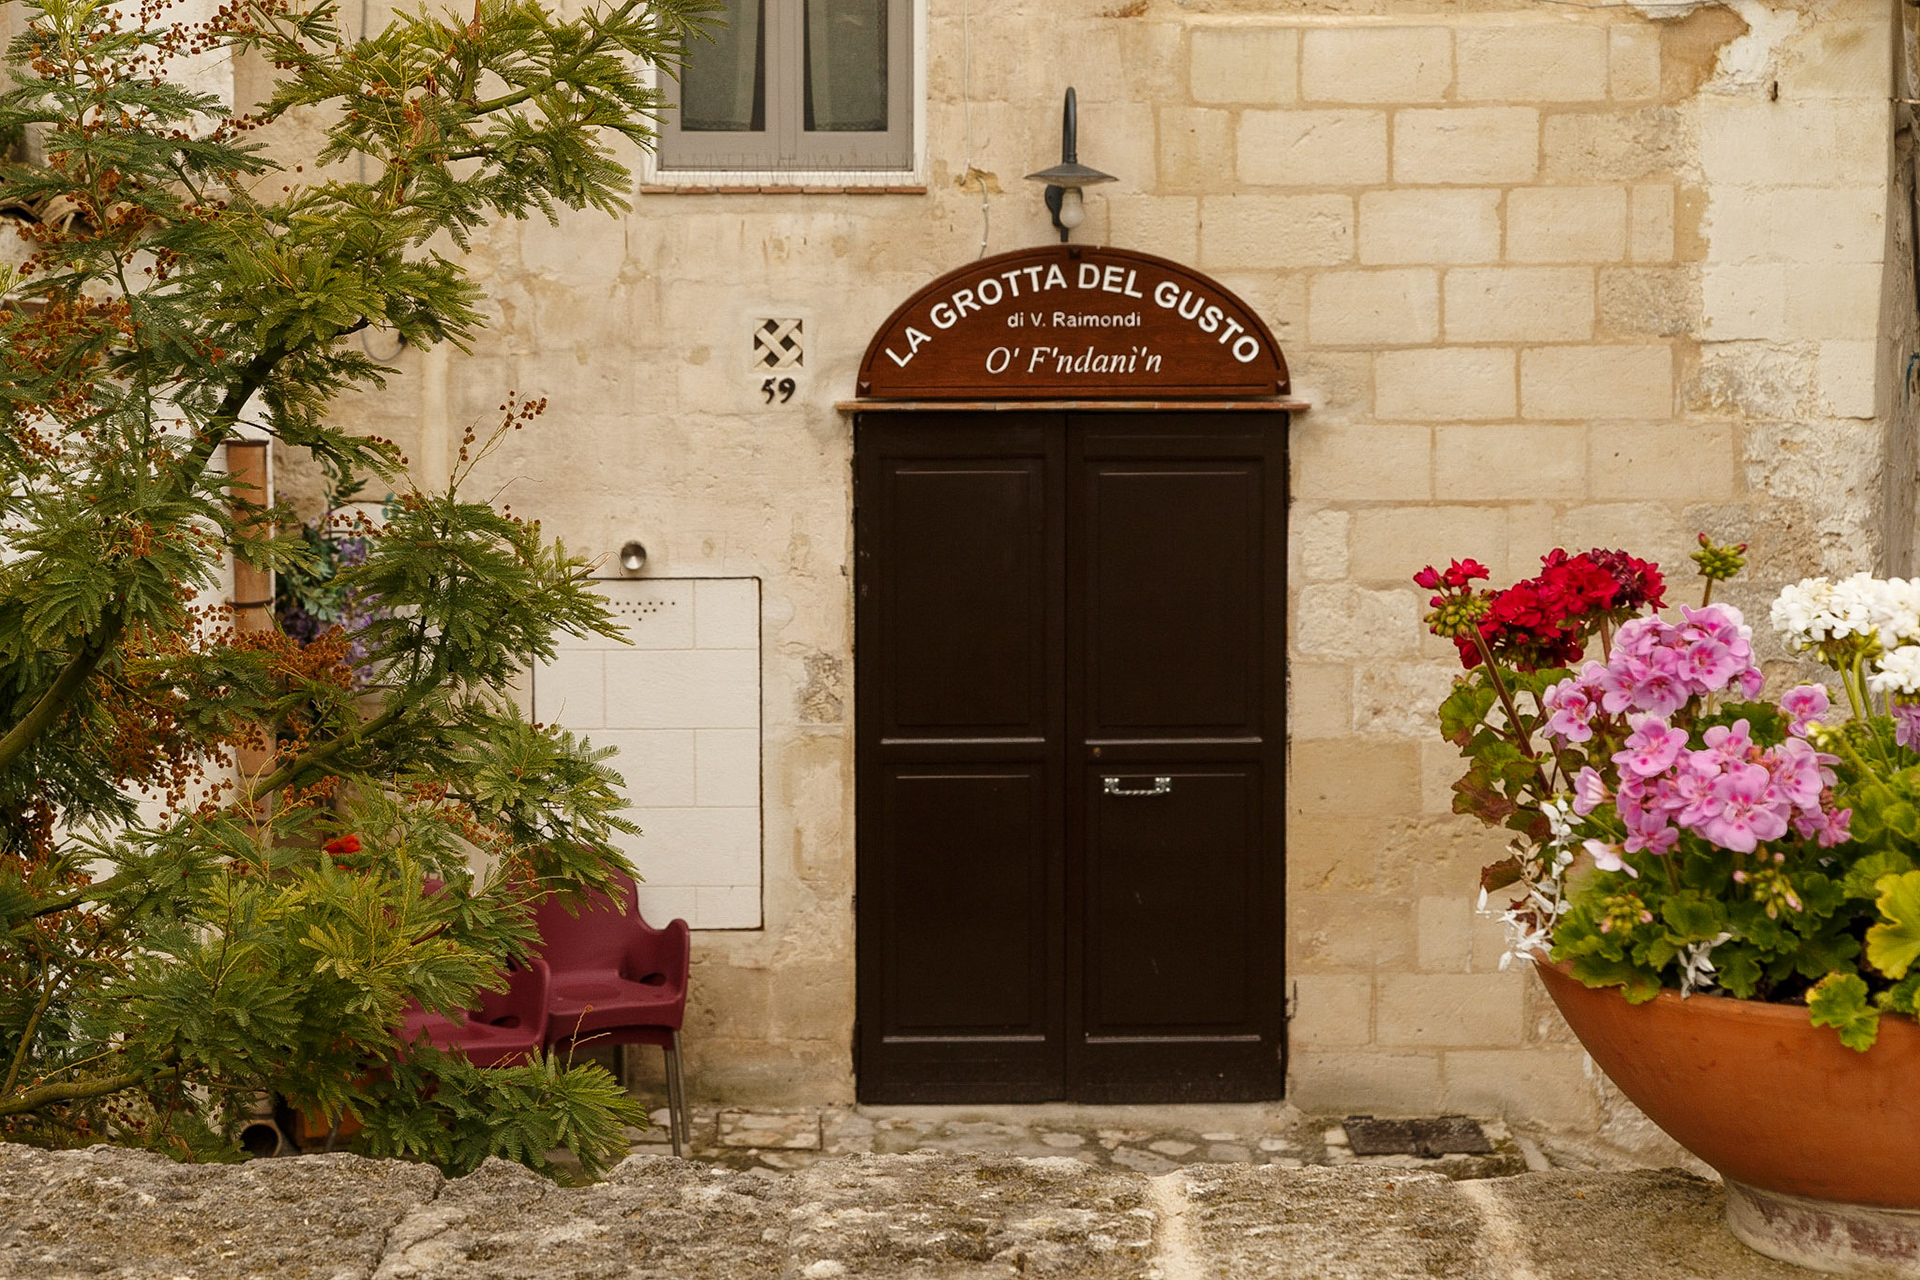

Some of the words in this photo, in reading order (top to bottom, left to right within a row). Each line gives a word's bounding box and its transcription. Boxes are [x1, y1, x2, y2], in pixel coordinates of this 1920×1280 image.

[884, 326, 932, 369] LA
[929, 264, 1068, 330] GROTTA
[1078, 263, 1144, 299] DEL
[1153, 281, 1261, 364] GUSTO
[1007, 311, 1025, 328] di
[1030, 312, 1047, 328] V.
[1052, 311, 1142, 328] Raimondi
[761, 376, 796, 405] 59
